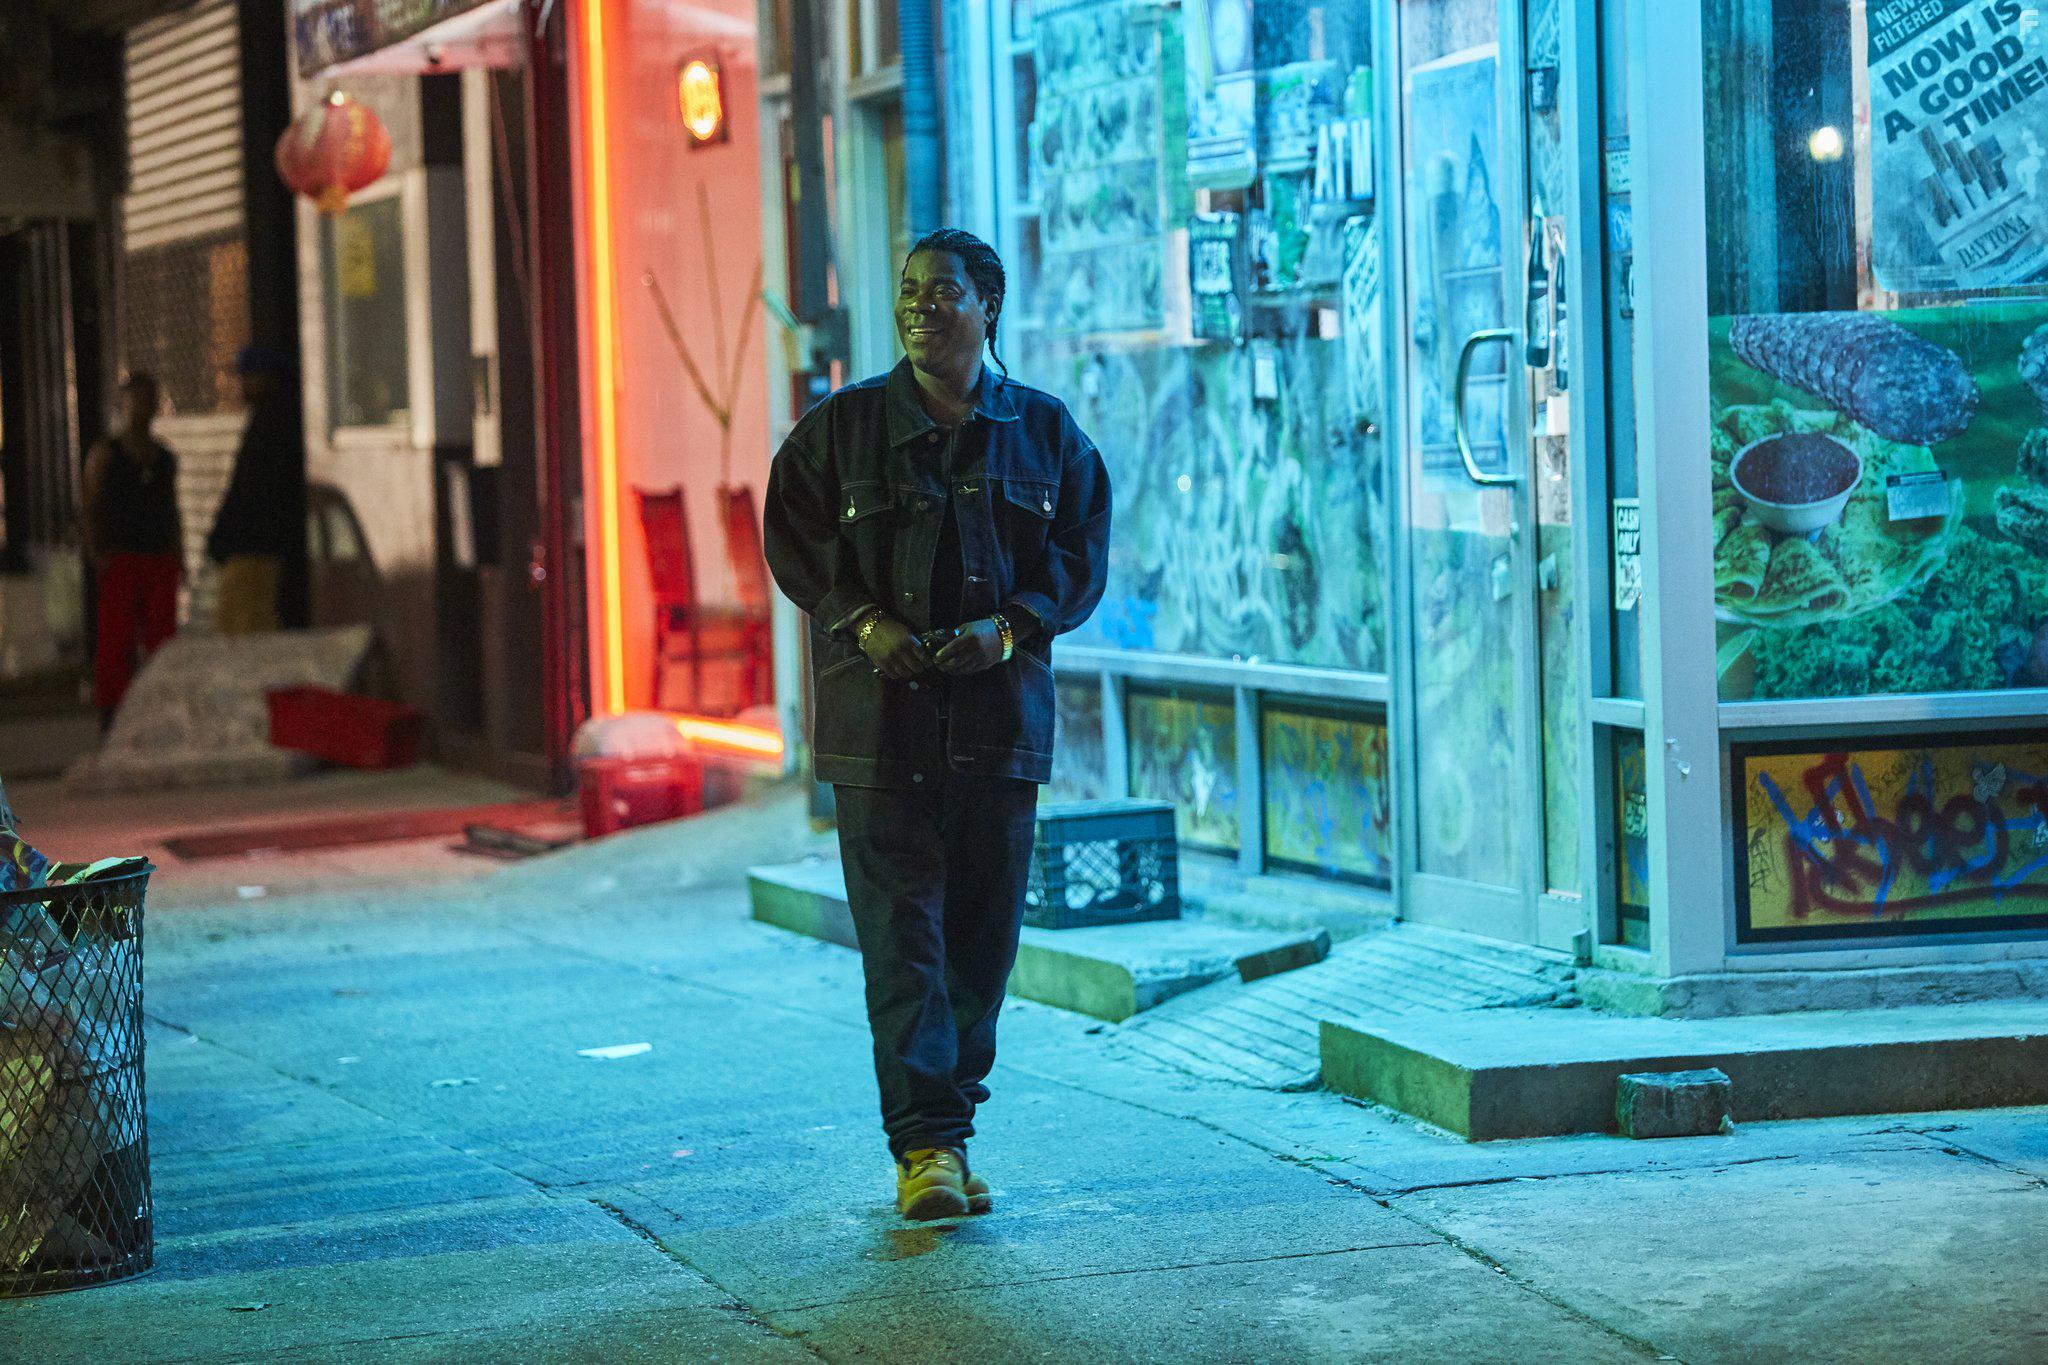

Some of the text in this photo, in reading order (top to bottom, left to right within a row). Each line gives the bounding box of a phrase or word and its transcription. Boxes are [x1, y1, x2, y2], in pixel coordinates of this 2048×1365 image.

[1873, 0, 1944, 52] FILTERED
[1875, 0, 1922, 28] NEW
[1881, 0, 2023, 99] NOW IS
[1883, 35, 2024, 144] A GOOD
[1956, 214, 2031, 269] DAYTONA
